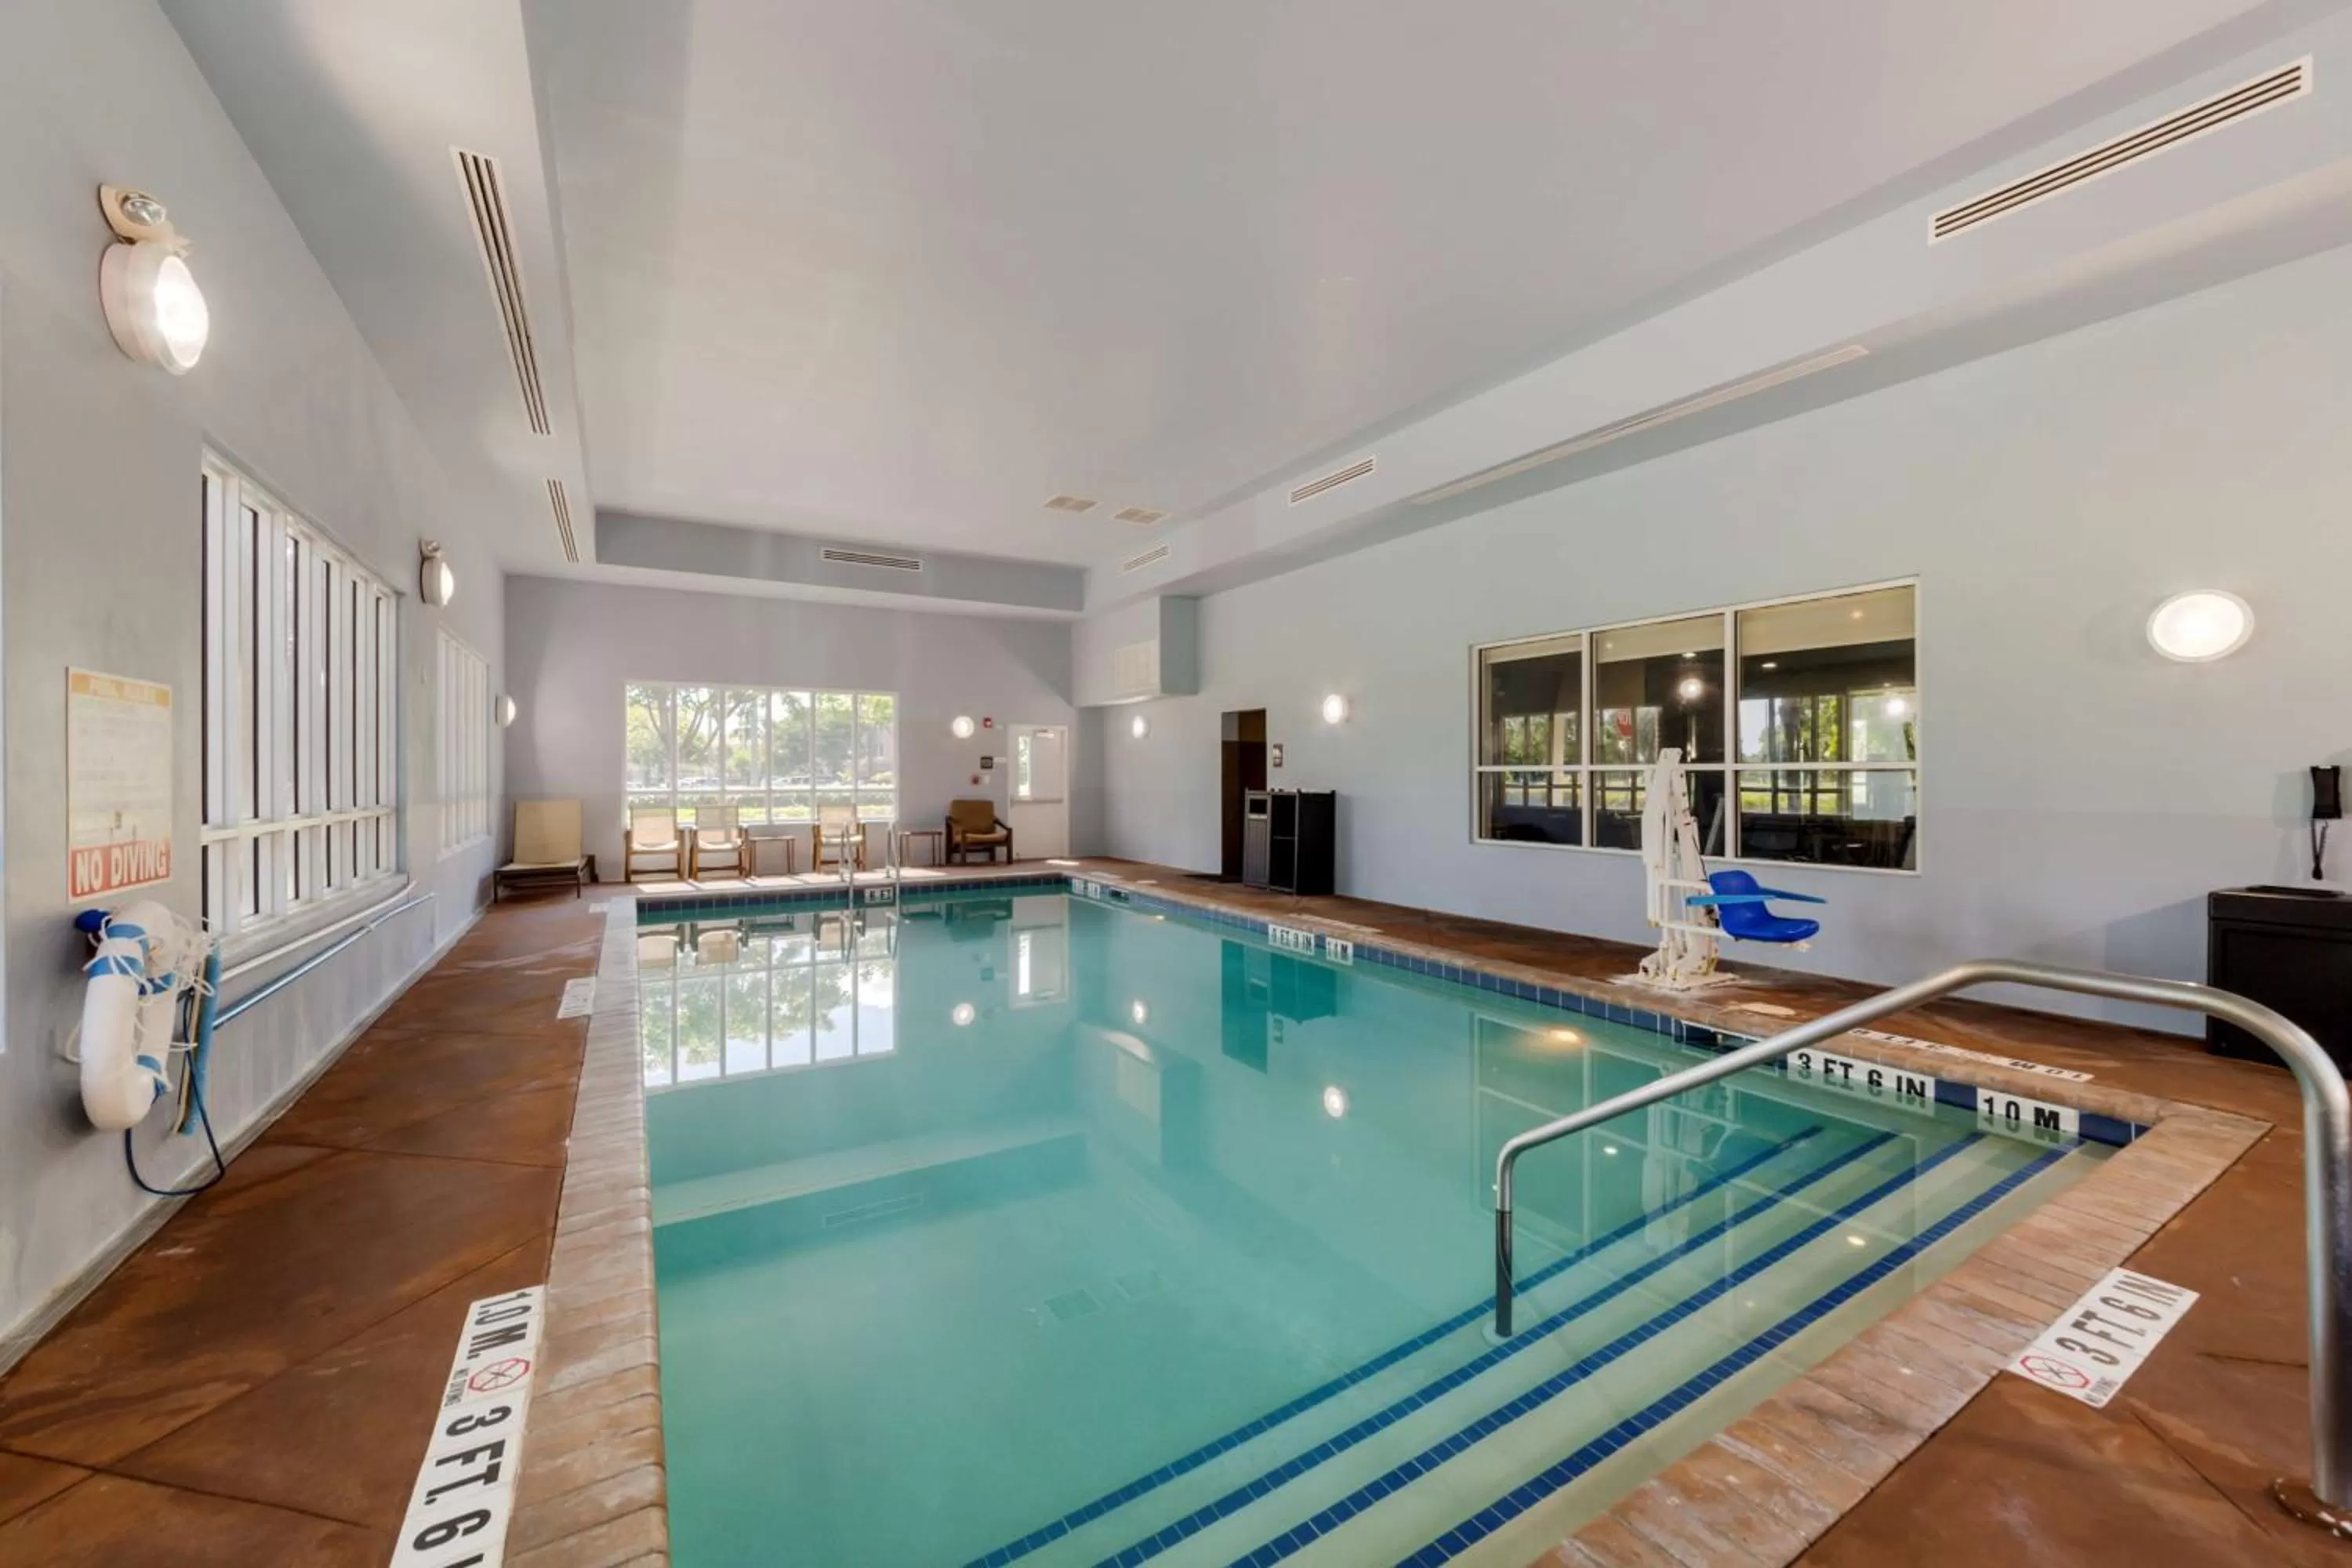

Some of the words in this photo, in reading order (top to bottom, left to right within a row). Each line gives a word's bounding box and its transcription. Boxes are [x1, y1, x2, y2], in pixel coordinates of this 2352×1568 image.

[75, 849, 103, 895] NO
[111, 842, 168, 887] DIVING
[1798, 1053, 1812, 1070] 3
[1823, 1058, 1854, 1080] FT
[1867, 1069, 1883, 1087] 6
[1896, 1075, 1926, 1098] IN
[2034, 1106, 2060, 1131] M
[2099, 1295, 2162, 1321] 6
[2112, 1274, 2187, 1308] IN
[2054, 1336, 2120, 1366] 3
[445, 1405, 512, 1438] 3
[423, 1439, 506, 1506] FT.
[412, 1508, 492, 1552] 6
